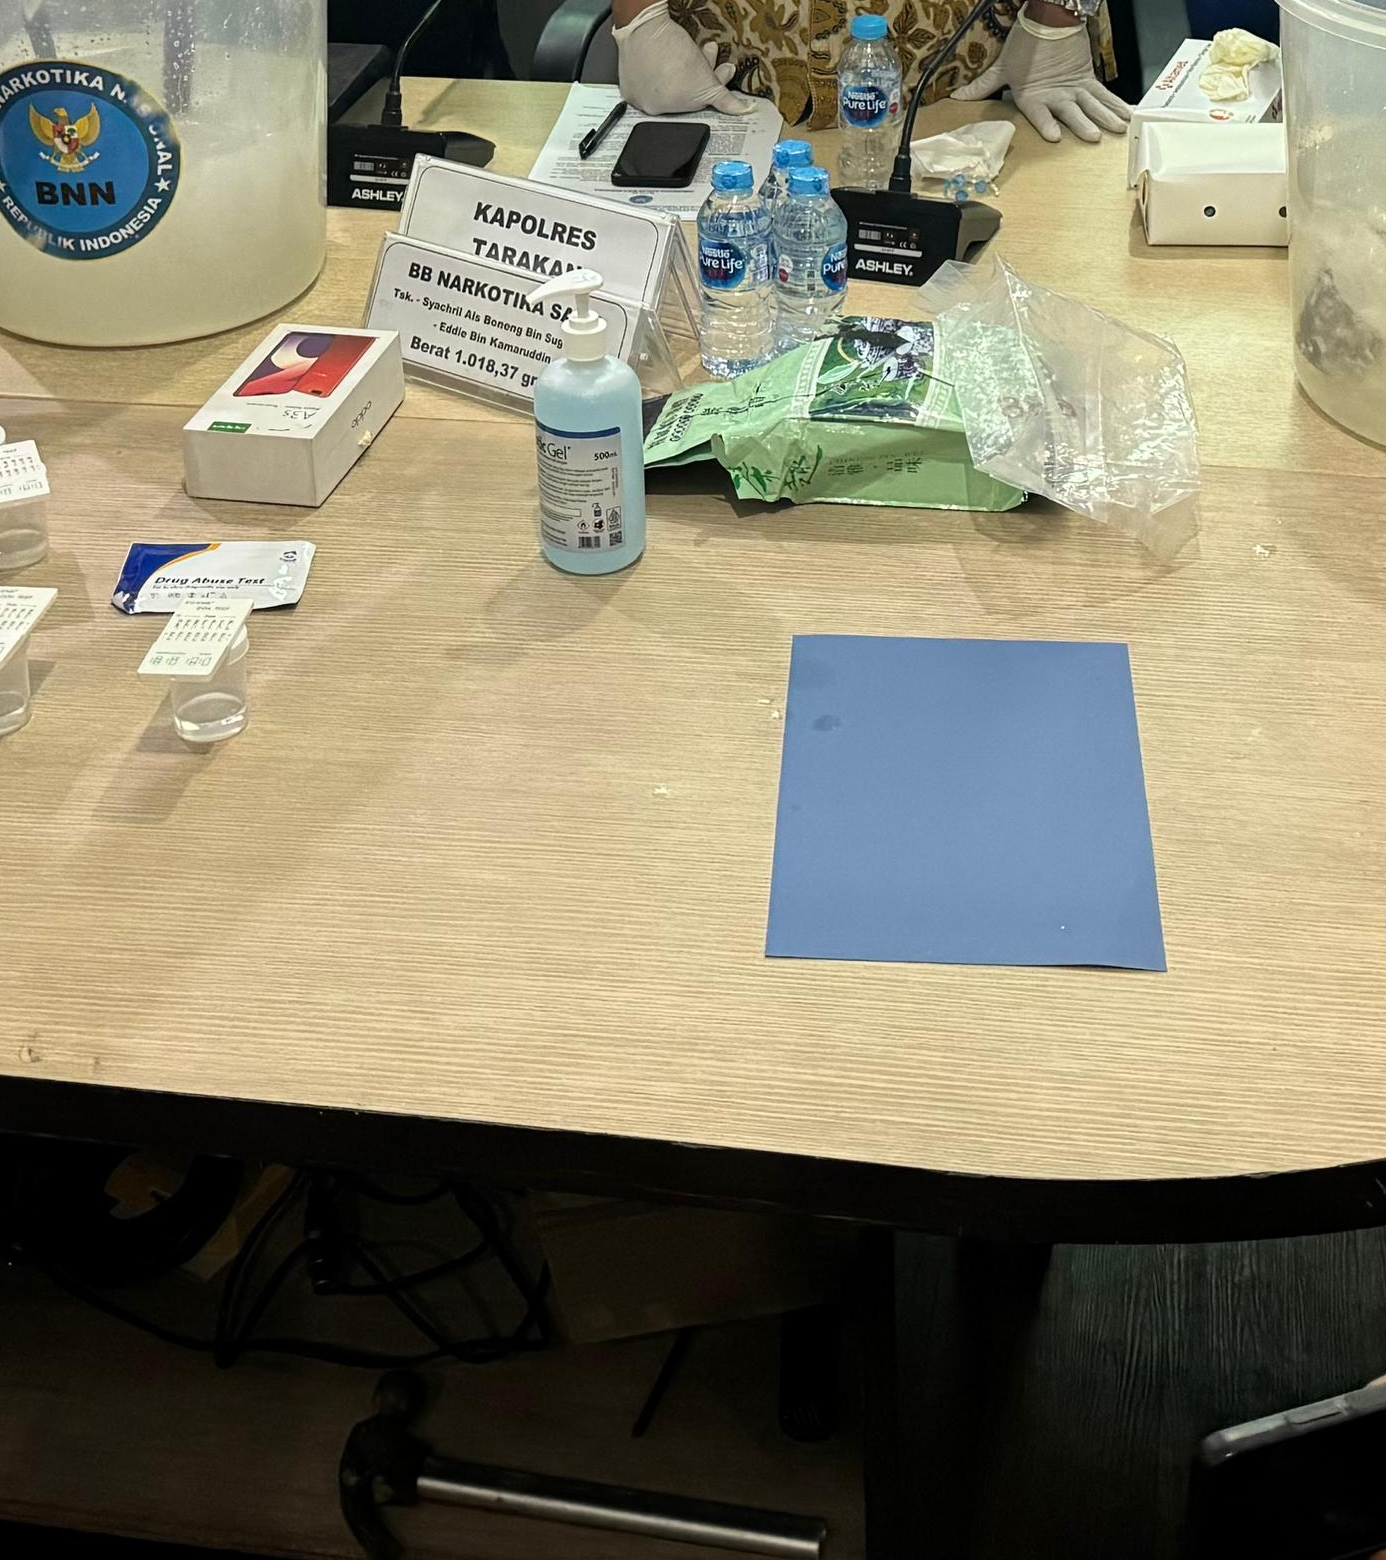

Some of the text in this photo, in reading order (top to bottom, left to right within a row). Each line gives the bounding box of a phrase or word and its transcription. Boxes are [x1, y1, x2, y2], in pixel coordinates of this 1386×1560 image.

[843, 97, 886, 113] Pure Life
[35, 181, 116, 206] BNN
[351, 188, 403, 201] ASHLEY
[80, 197, 162, 251] INDONESIA
[473, 202, 597, 250] KAPOLRES
[408, 262, 433, 282] BB
[721, 258, 743, 273] Life
[855, 259, 913, 275] ASHLEY
[394, 289, 414, 303] Tsk.
[422, 297, 463, 317] Syachril
[465, 310, 481, 323] Als
[484, 315, 523, 337] Boneng
[526, 326, 542, 340] Bin
[440, 322, 467, 339] Eddie
[470, 330, 486, 344] Bin
[490, 336, 551, 364] Kamaruddin
[410, 336, 450, 359] Berat
[455, 350, 519, 379] 1.018,37
[547, 442, 567, 460] Gel
[154, 577, 189, 585] Drug
